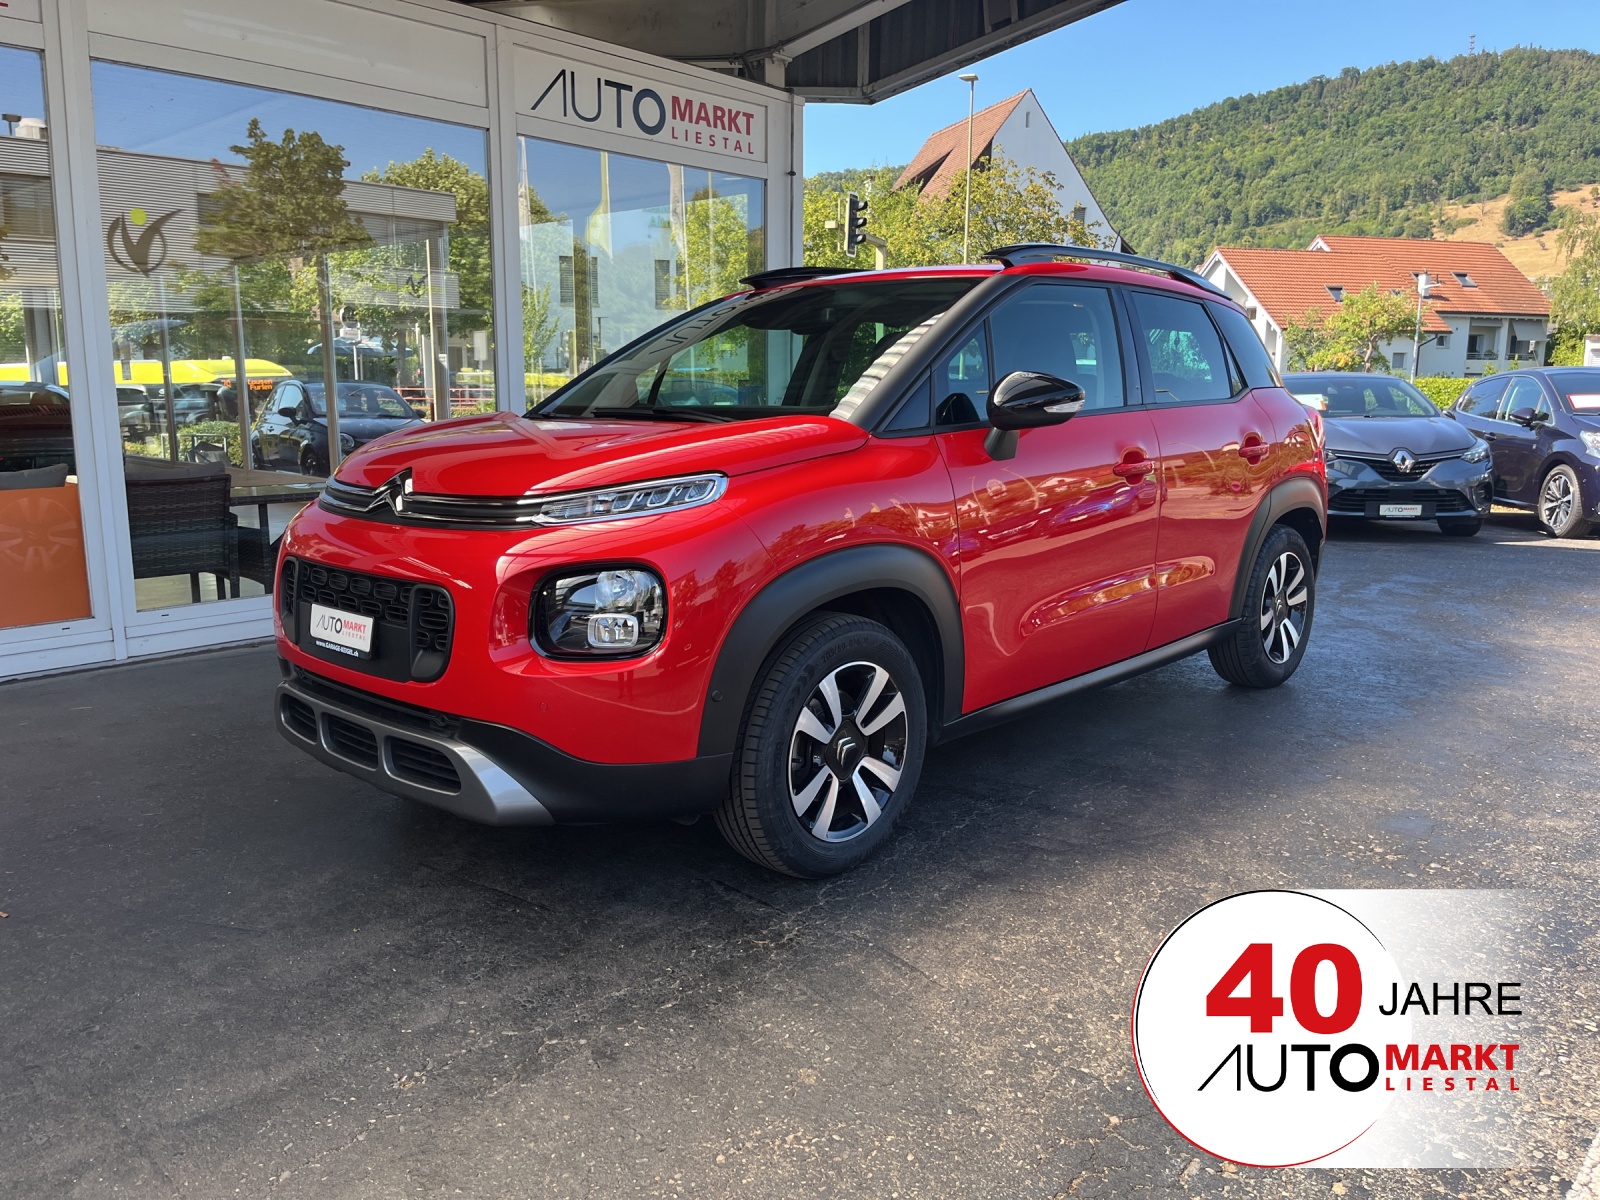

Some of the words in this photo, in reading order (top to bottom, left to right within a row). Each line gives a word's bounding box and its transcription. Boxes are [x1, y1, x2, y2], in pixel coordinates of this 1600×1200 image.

[530, 69, 666, 135] AUTO
[671, 95, 754, 136] MARKT
[672, 126, 754, 154] LIESTAL
[316, 614, 342, 634] AUTO
[343, 619, 366, 634] MARKT
[342, 631, 366, 641] LIESTAL
